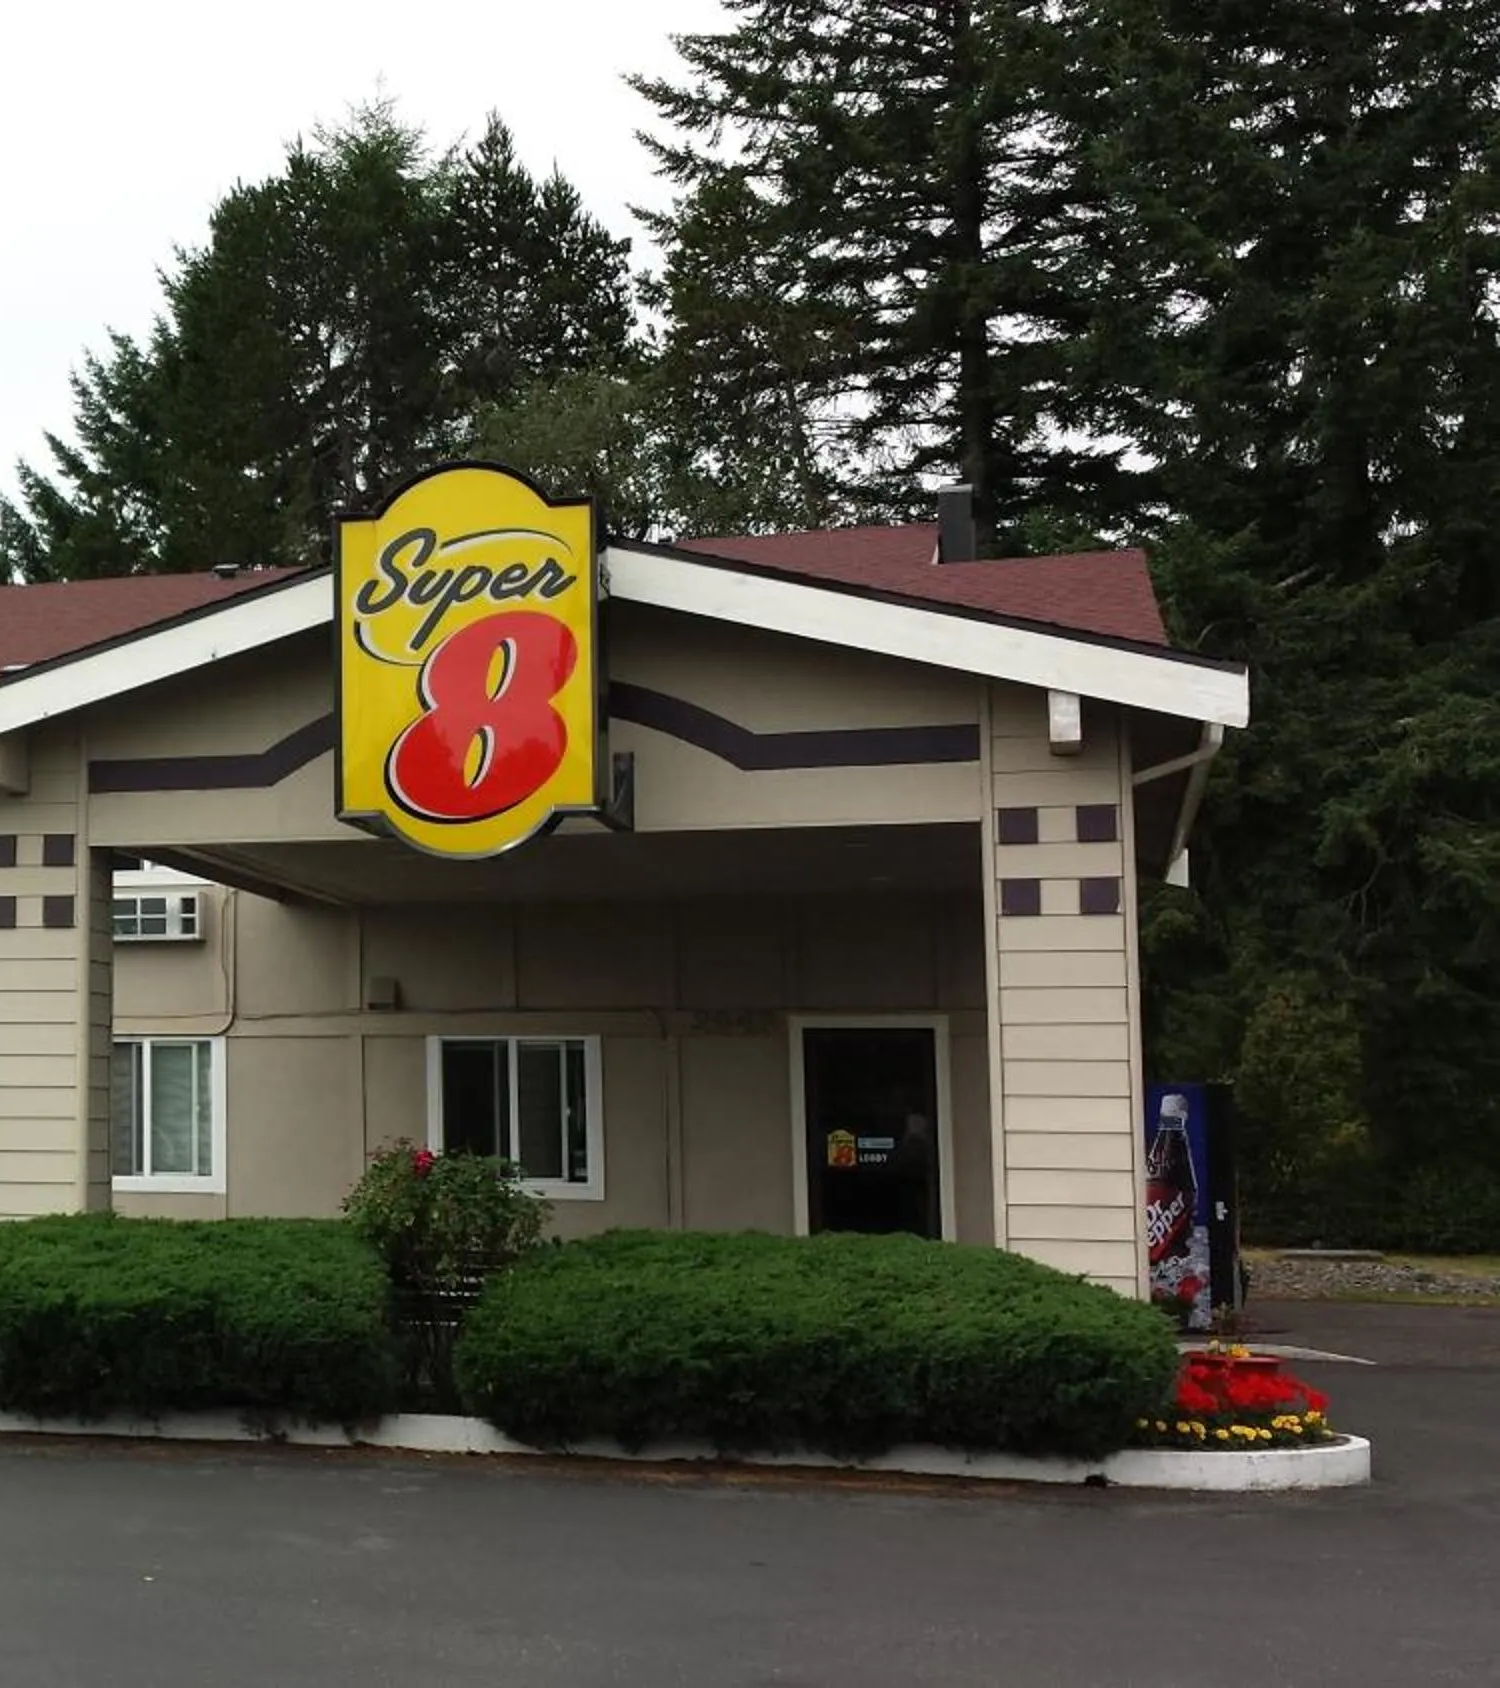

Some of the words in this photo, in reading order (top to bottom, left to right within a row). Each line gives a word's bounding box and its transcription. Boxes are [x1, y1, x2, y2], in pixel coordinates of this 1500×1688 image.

[356, 527, 578, 651] Super
[384, 609, 578, 824] 8
[1147, 1190, 1185, 1247] epper
